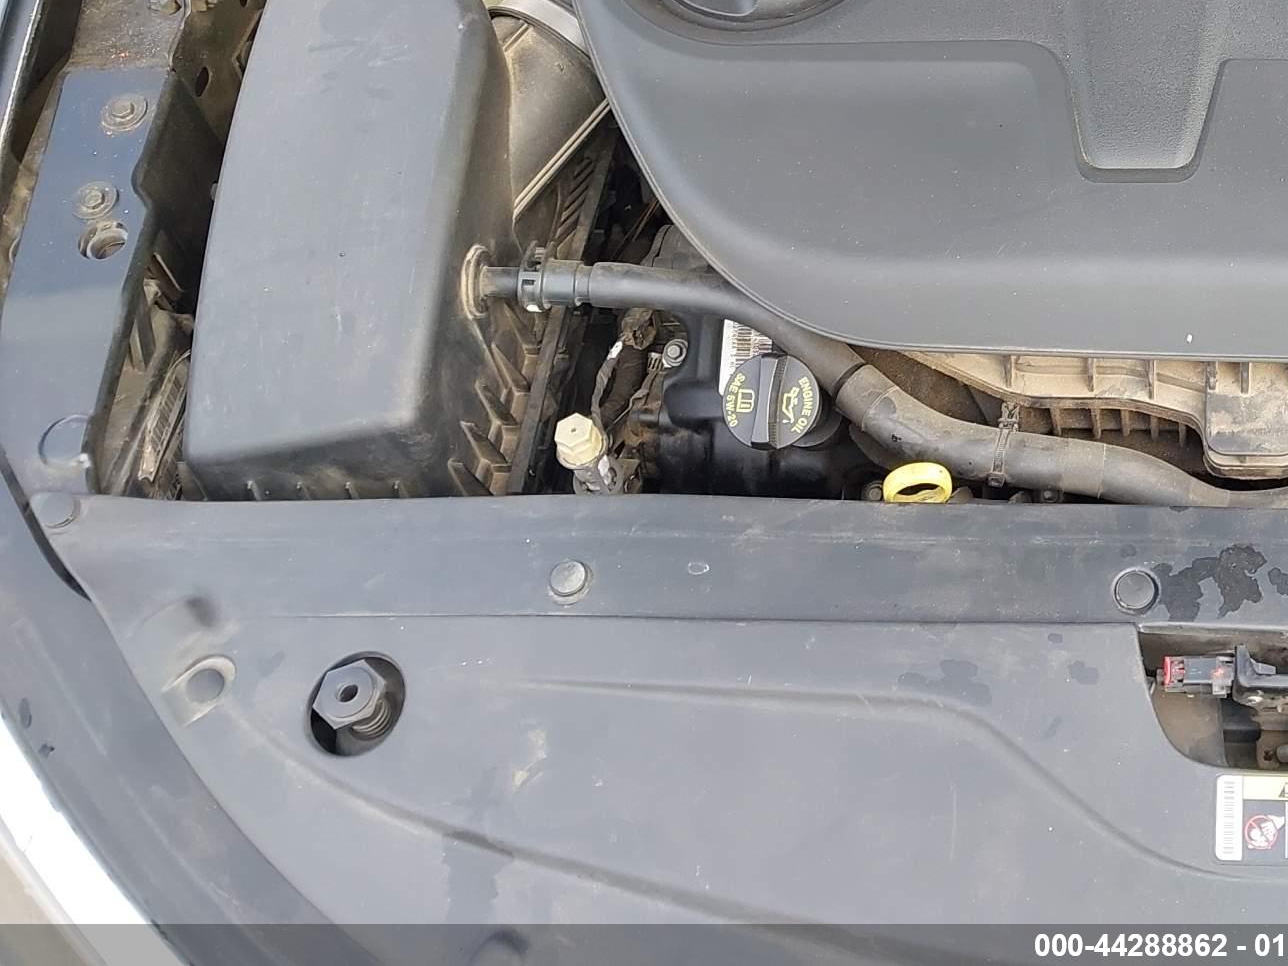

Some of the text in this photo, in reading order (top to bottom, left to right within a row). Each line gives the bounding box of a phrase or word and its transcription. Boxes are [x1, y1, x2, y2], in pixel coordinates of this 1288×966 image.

[728, 372, 746, 394] SAE
[726, 394, 739, 428] 5W-20
[790, 376, 814, 434] ENGINE OIL
